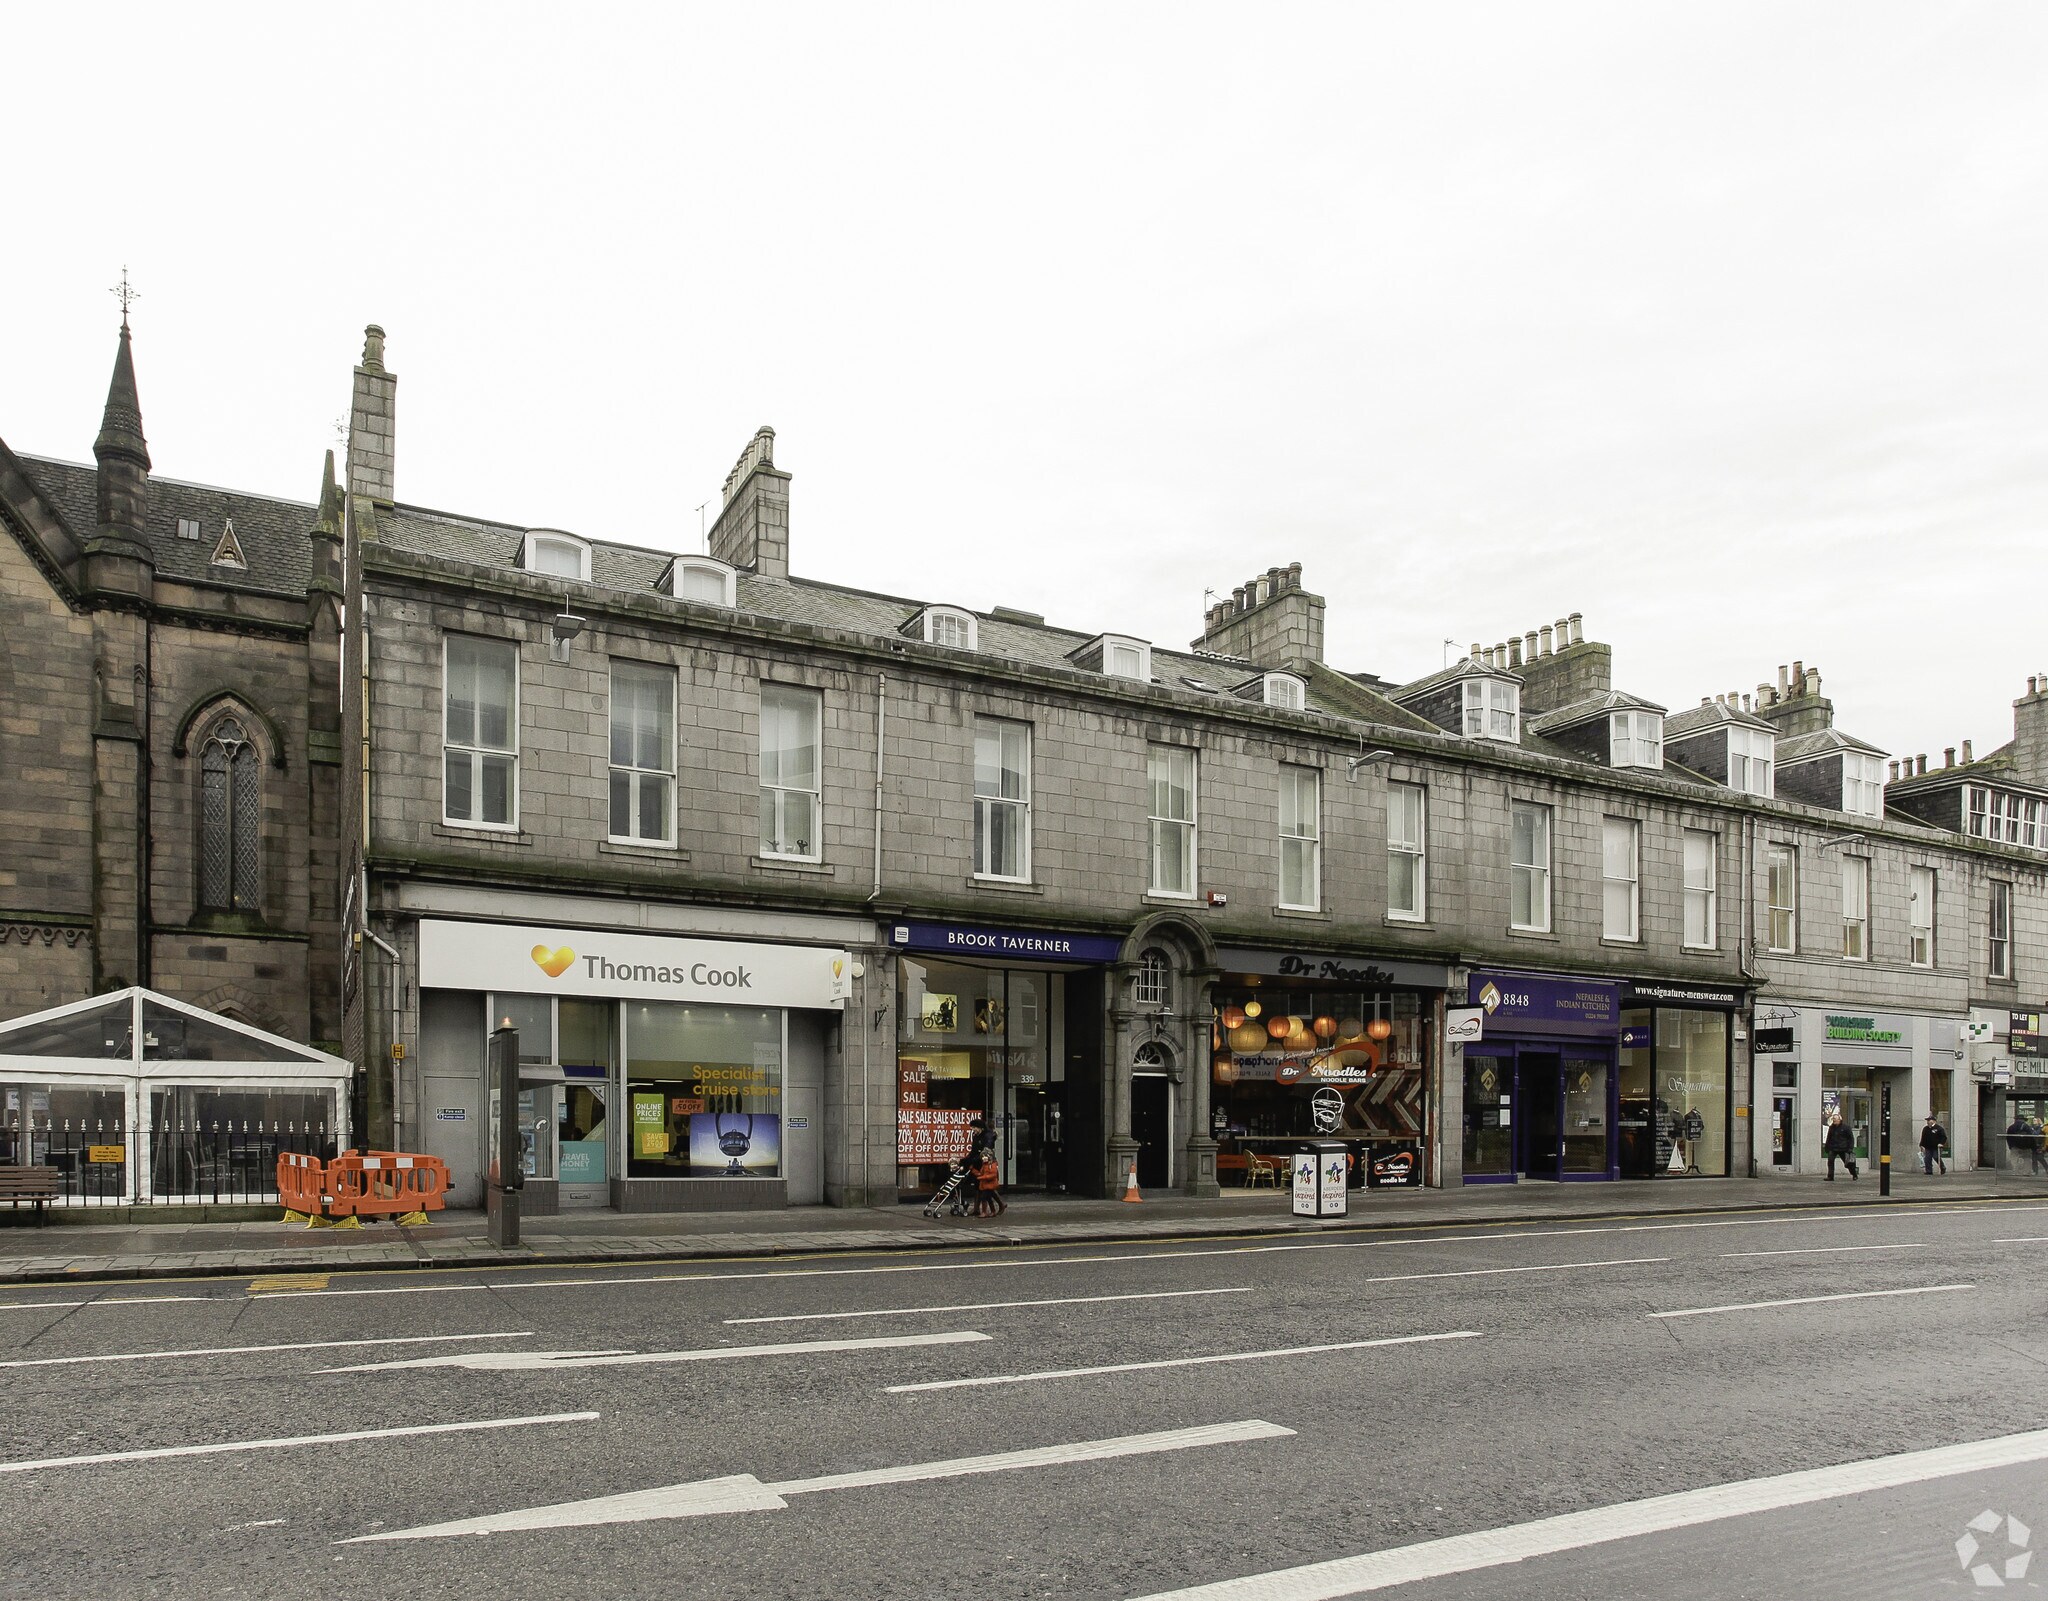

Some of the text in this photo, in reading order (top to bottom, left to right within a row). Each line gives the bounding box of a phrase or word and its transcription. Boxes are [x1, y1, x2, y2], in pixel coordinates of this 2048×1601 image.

[948, 932, 1071, 953] BROOK TAVERNER
[582, 955, 752, 988] Thomas Cook
[1278, 956, 1394, 983] Dr Noodles
[1503, 994, 1529, 1006] 8848
[1576, 993, 1604, 1002] NEPALESE
[1634, 986, 1734, 1002] www.signature-menswear.com
[1556, 1000, 1610, 1011] INDIAN KITCHEN
[1825, 1015, 1875, 1029] YORKSHIRE
[1827, 1026, 1902, 1042] BUILDING SOCIETY
[393, 1045, 402, 1057] H
[692, 1064, 765, 1082] Specialist
[903, 1071, 926, 1084] SALE
[1282, 1066, 1367, 1077] Dr Noodles
[1020, 1075, 1034, 1083] 339
[693, 1082, 778, 1096] cruise store
[1668, 1077, 1714, 1096] Signature
[903, 1092, 926, 1103] SALE
[898, 1110, 914, 1124] SALE
[915, 1111, 931, 1124] SALE
[933, 1111, 948, 1124] SALE
[950, 1112, 965, 1124] SALE
[898, 1129, 914, 1144] 70%
[916, 1130, 932, 1144] 70%
[934, 1130, 949, 1144] 70%
[951, 1130, 965, 1144] 70%
